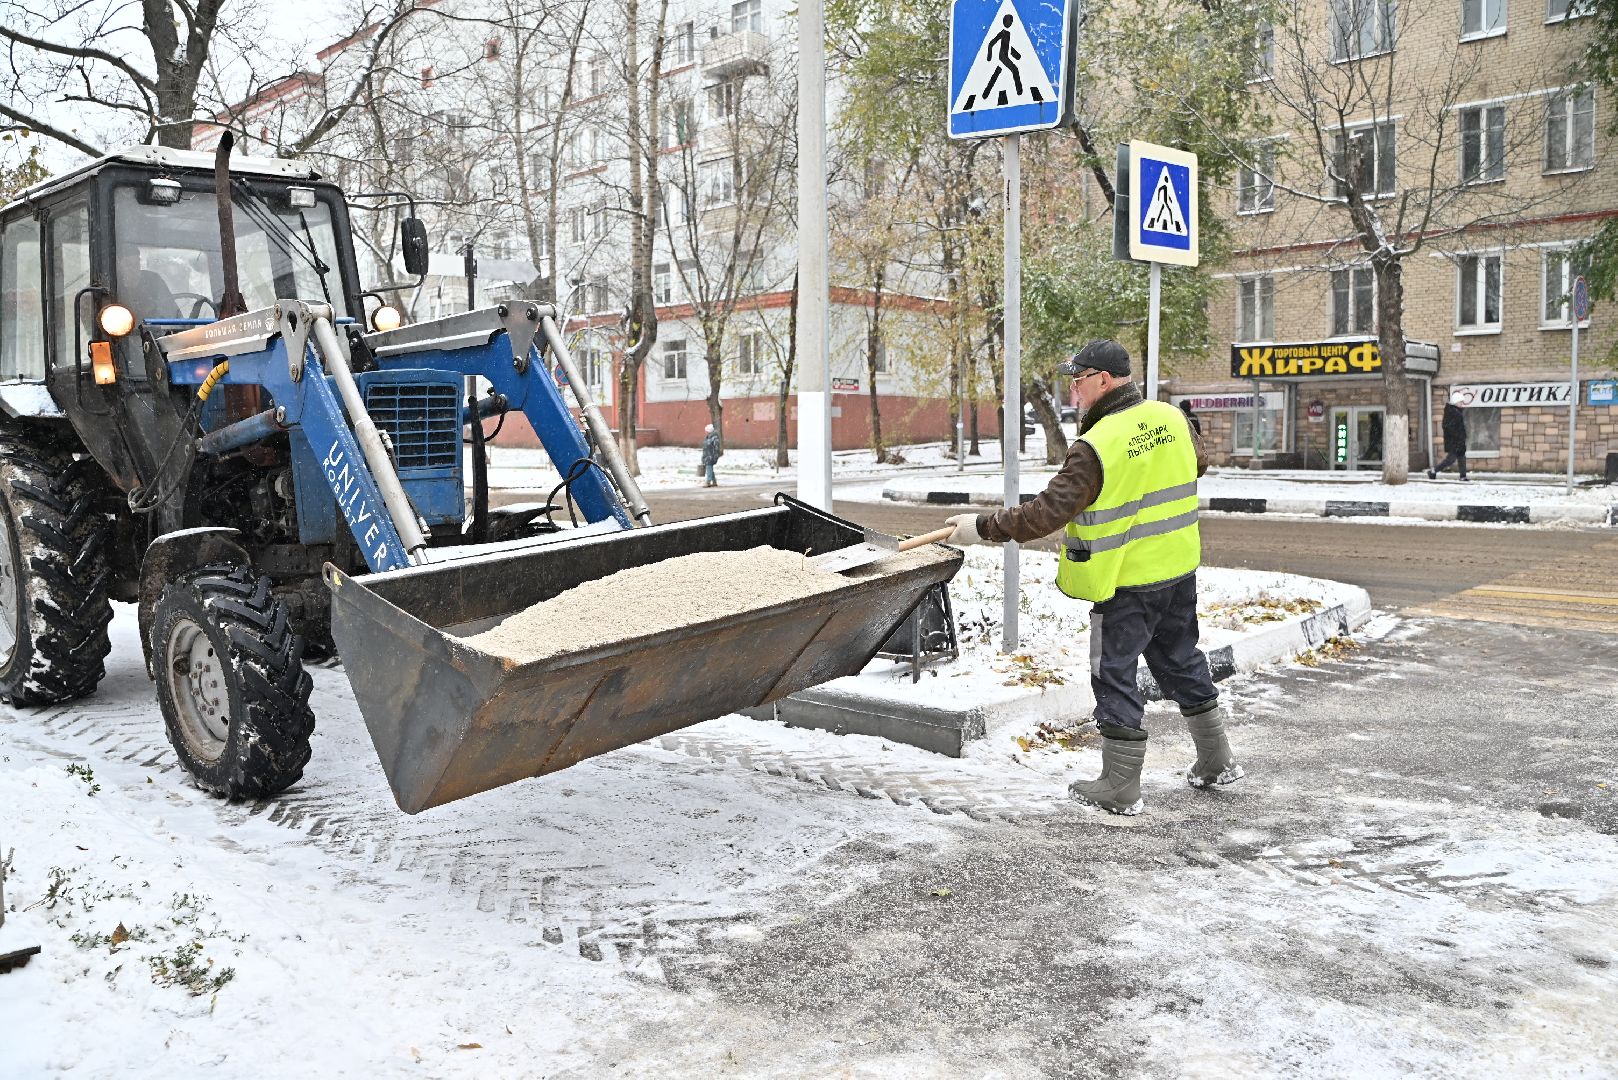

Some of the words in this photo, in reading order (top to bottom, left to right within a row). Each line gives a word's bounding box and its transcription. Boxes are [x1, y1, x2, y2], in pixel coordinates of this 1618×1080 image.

[1274, 345, 1319, 358] ТОРГОВЫЙ
[1321, 344, 1349, 358] ЦЕНТР
[1127, 434, 1176, 459] ЛЫТКАИНО»
[322, 457, 357, 527] ROBUST
